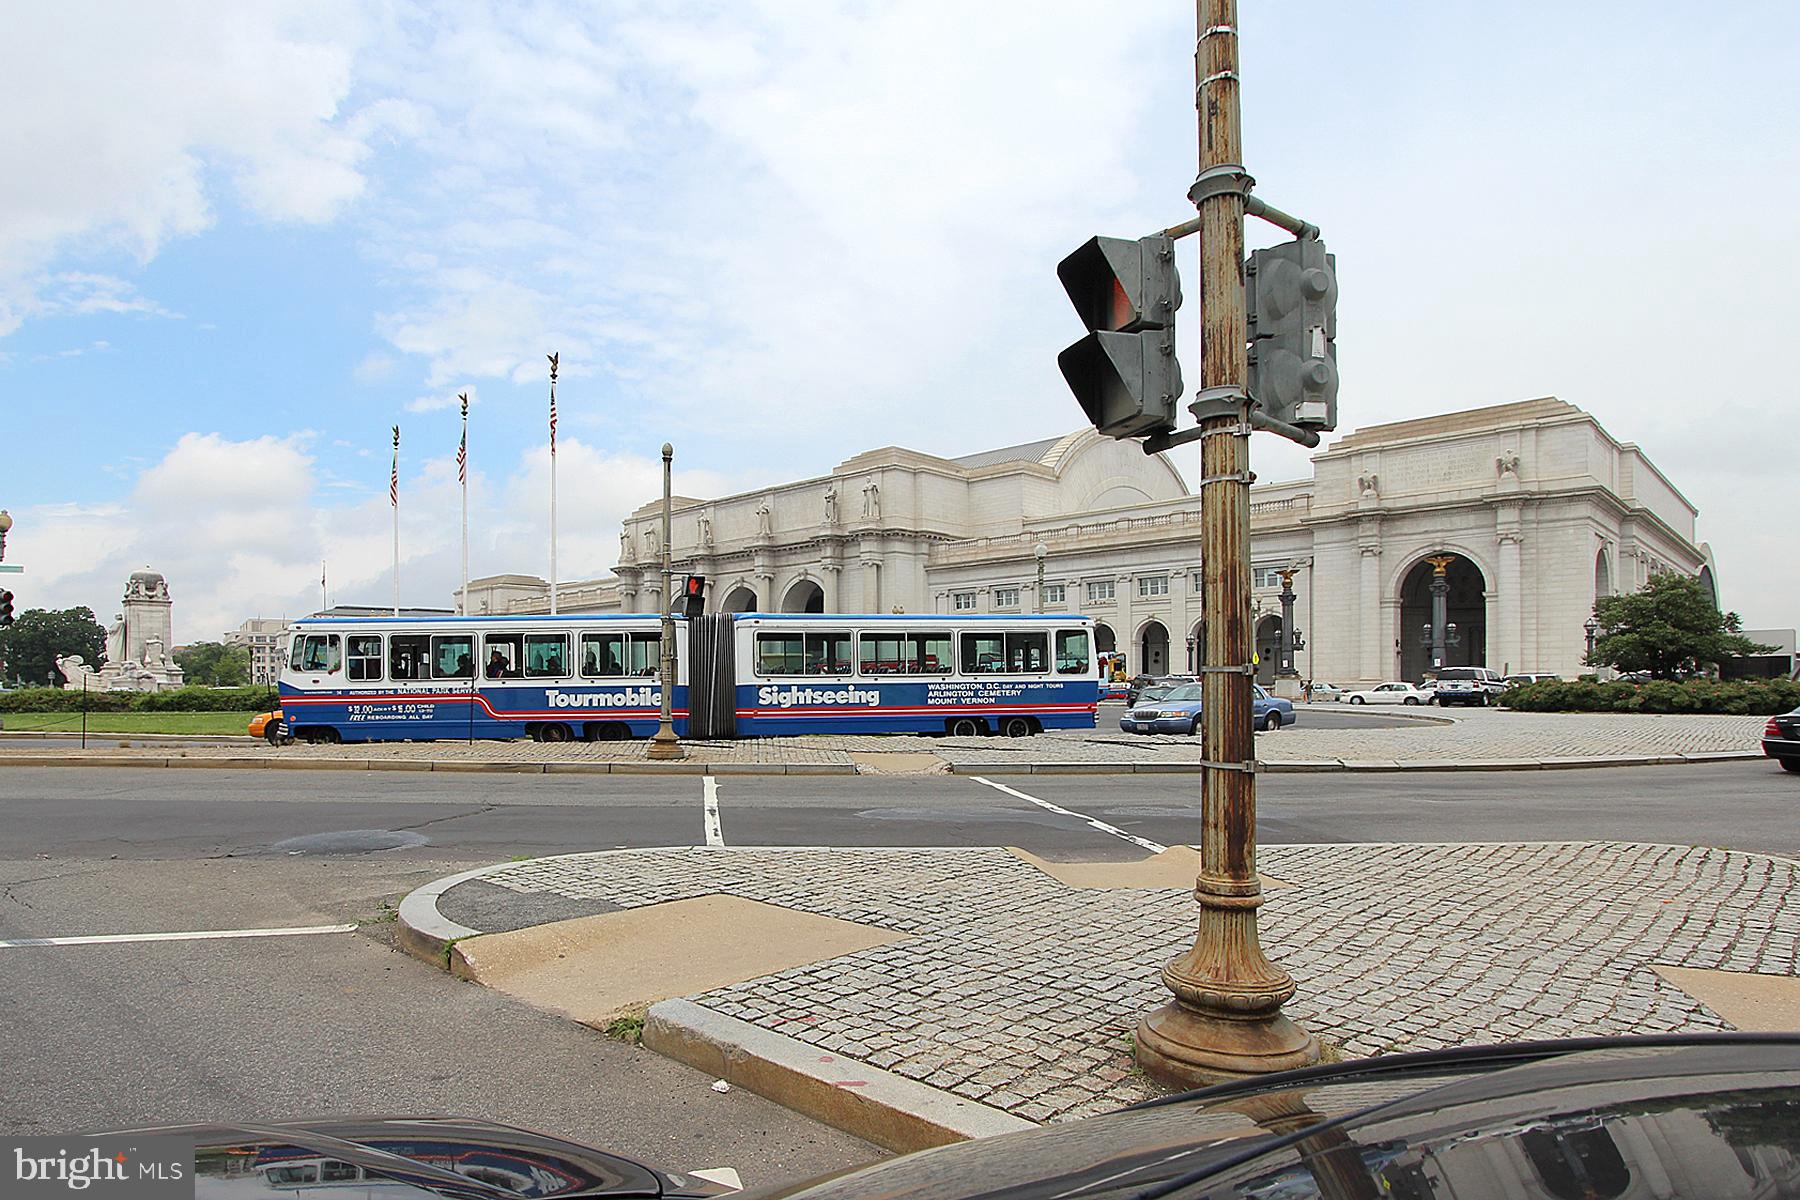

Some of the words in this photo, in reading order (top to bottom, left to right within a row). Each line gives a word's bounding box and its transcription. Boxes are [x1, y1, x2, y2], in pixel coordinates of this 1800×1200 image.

[545, 687, 662, 708] Tourmobile
[758, 684, 880, 708] Sightseeing
[928, 690, 974, 698] ARLINGTON
[978, 689, 1022, 697] CEMETERY
[928, 697, 958, 705] MOUNT
